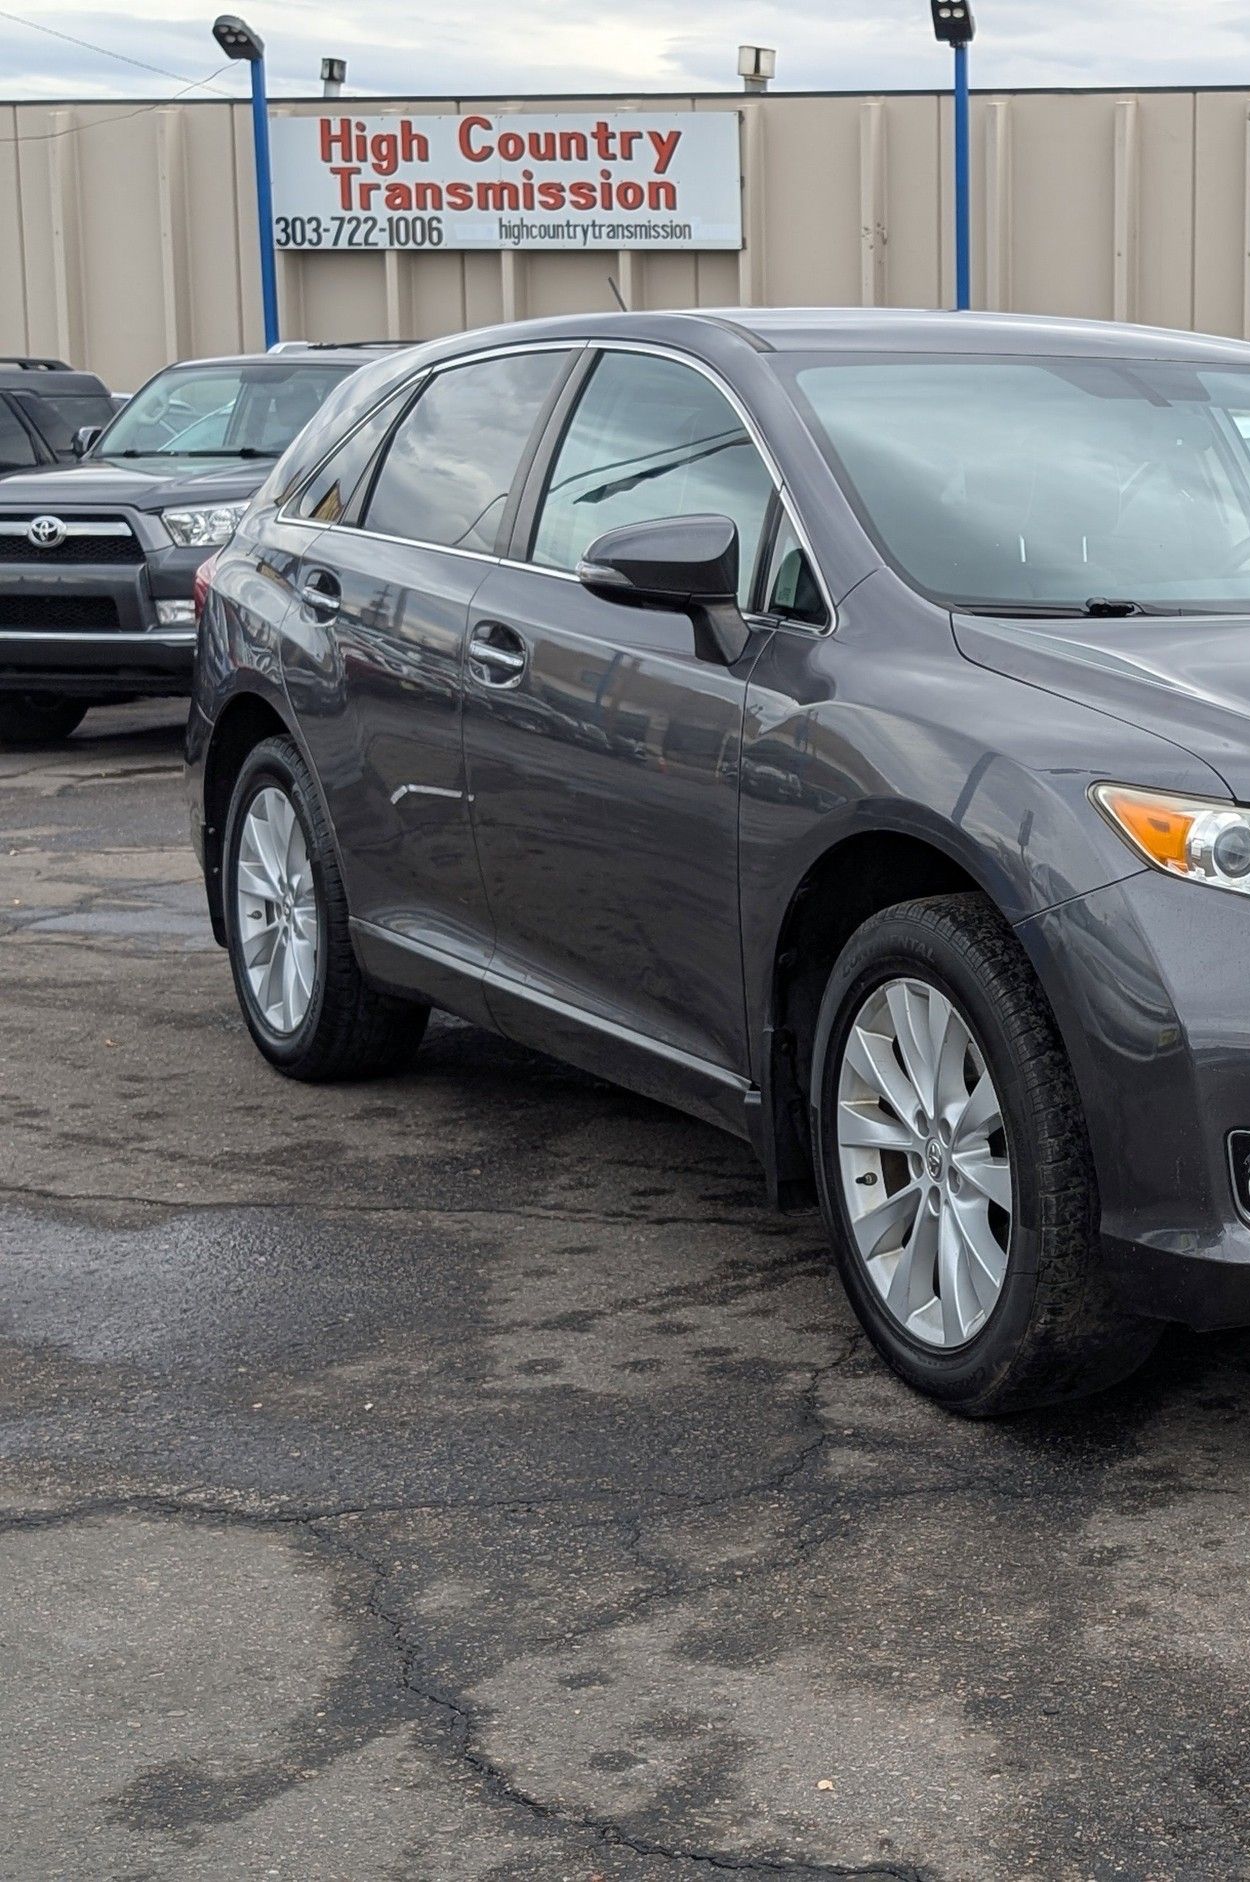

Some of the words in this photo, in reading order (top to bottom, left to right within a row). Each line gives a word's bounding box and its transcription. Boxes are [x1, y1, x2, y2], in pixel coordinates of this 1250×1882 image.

[319, 118, 429, 175] High
[459, 116, 682, 174] Country
[330, 167, 677, 211] Transmission
[275, 216, 443, 247] 303-722-1006
[499, 217, 692, 246] highcountrytransmission
